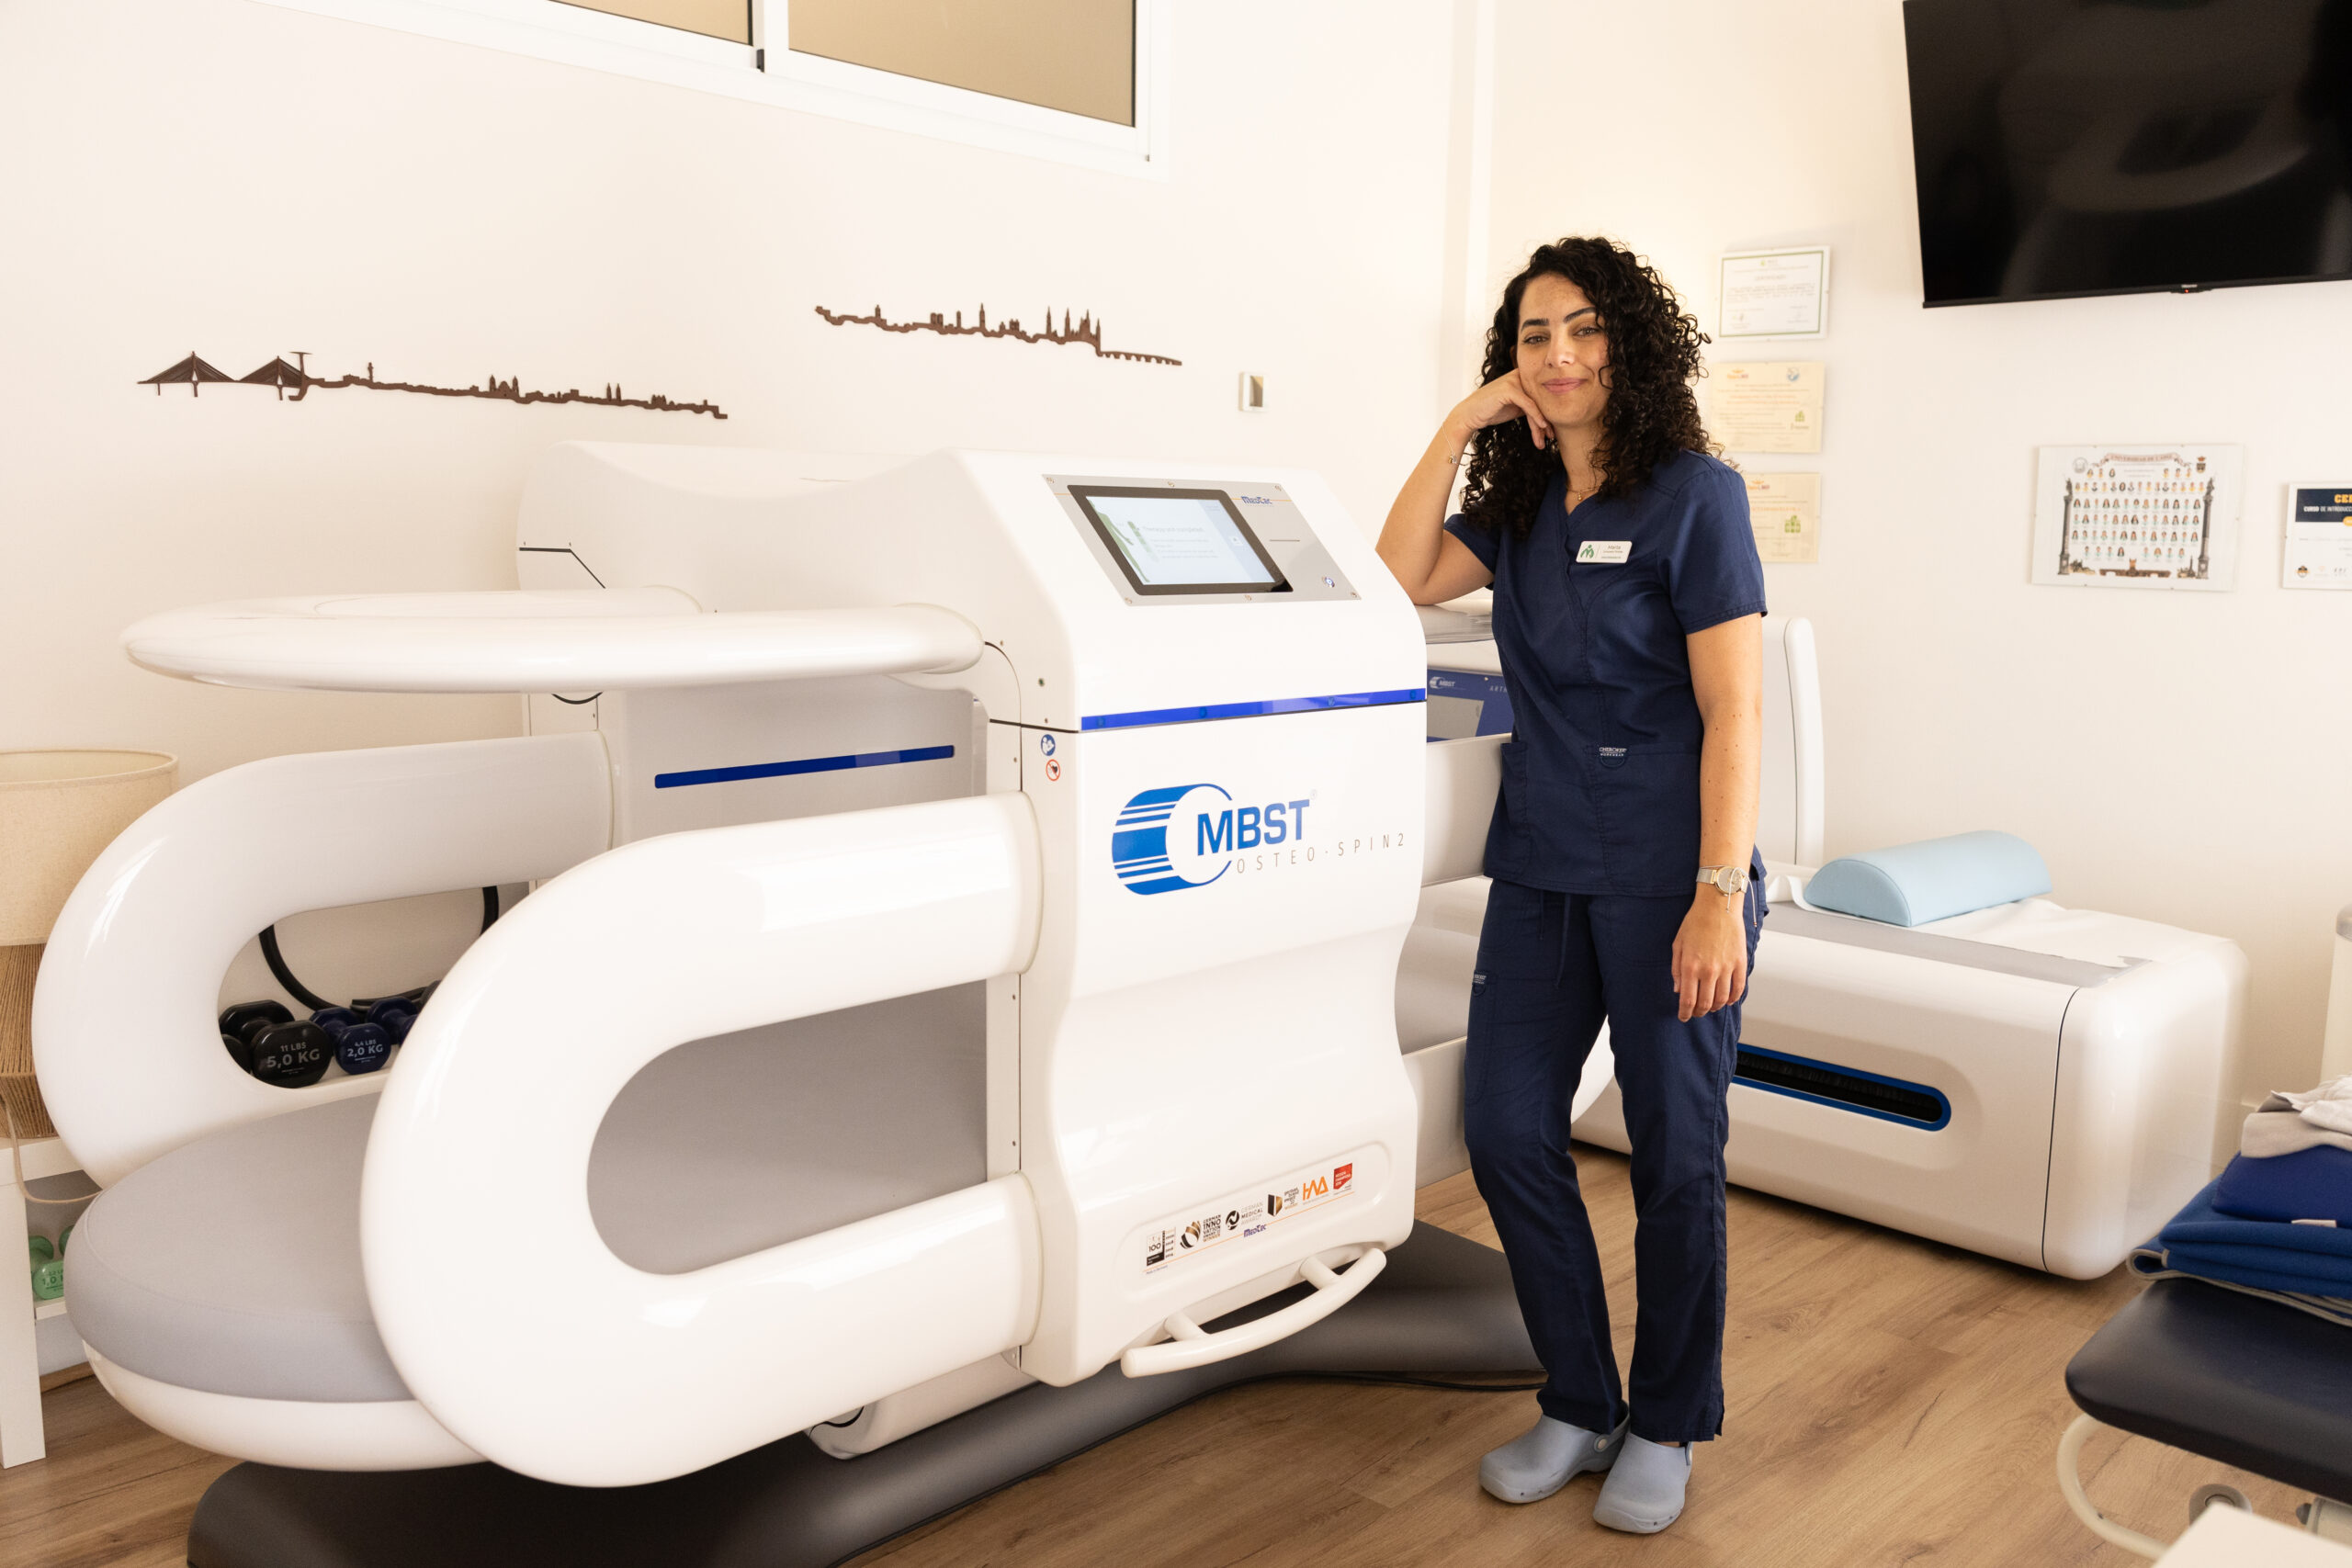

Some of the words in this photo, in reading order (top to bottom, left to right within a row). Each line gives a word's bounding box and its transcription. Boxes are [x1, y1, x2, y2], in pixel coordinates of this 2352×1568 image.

[1197, 799, 1310, 856] MBST
[280, 1044, 288, 1053] 11
[290, 1042, 307, 1051] LBS
[347, 1046, 365, 1058] 2,0
[368, 1043, 383, 1055] KG
[266, 1054, 293, 1069] 5,0
[298, 1048, 321, 1064] KG
[1148, 1242, 1162, 1253] 100
